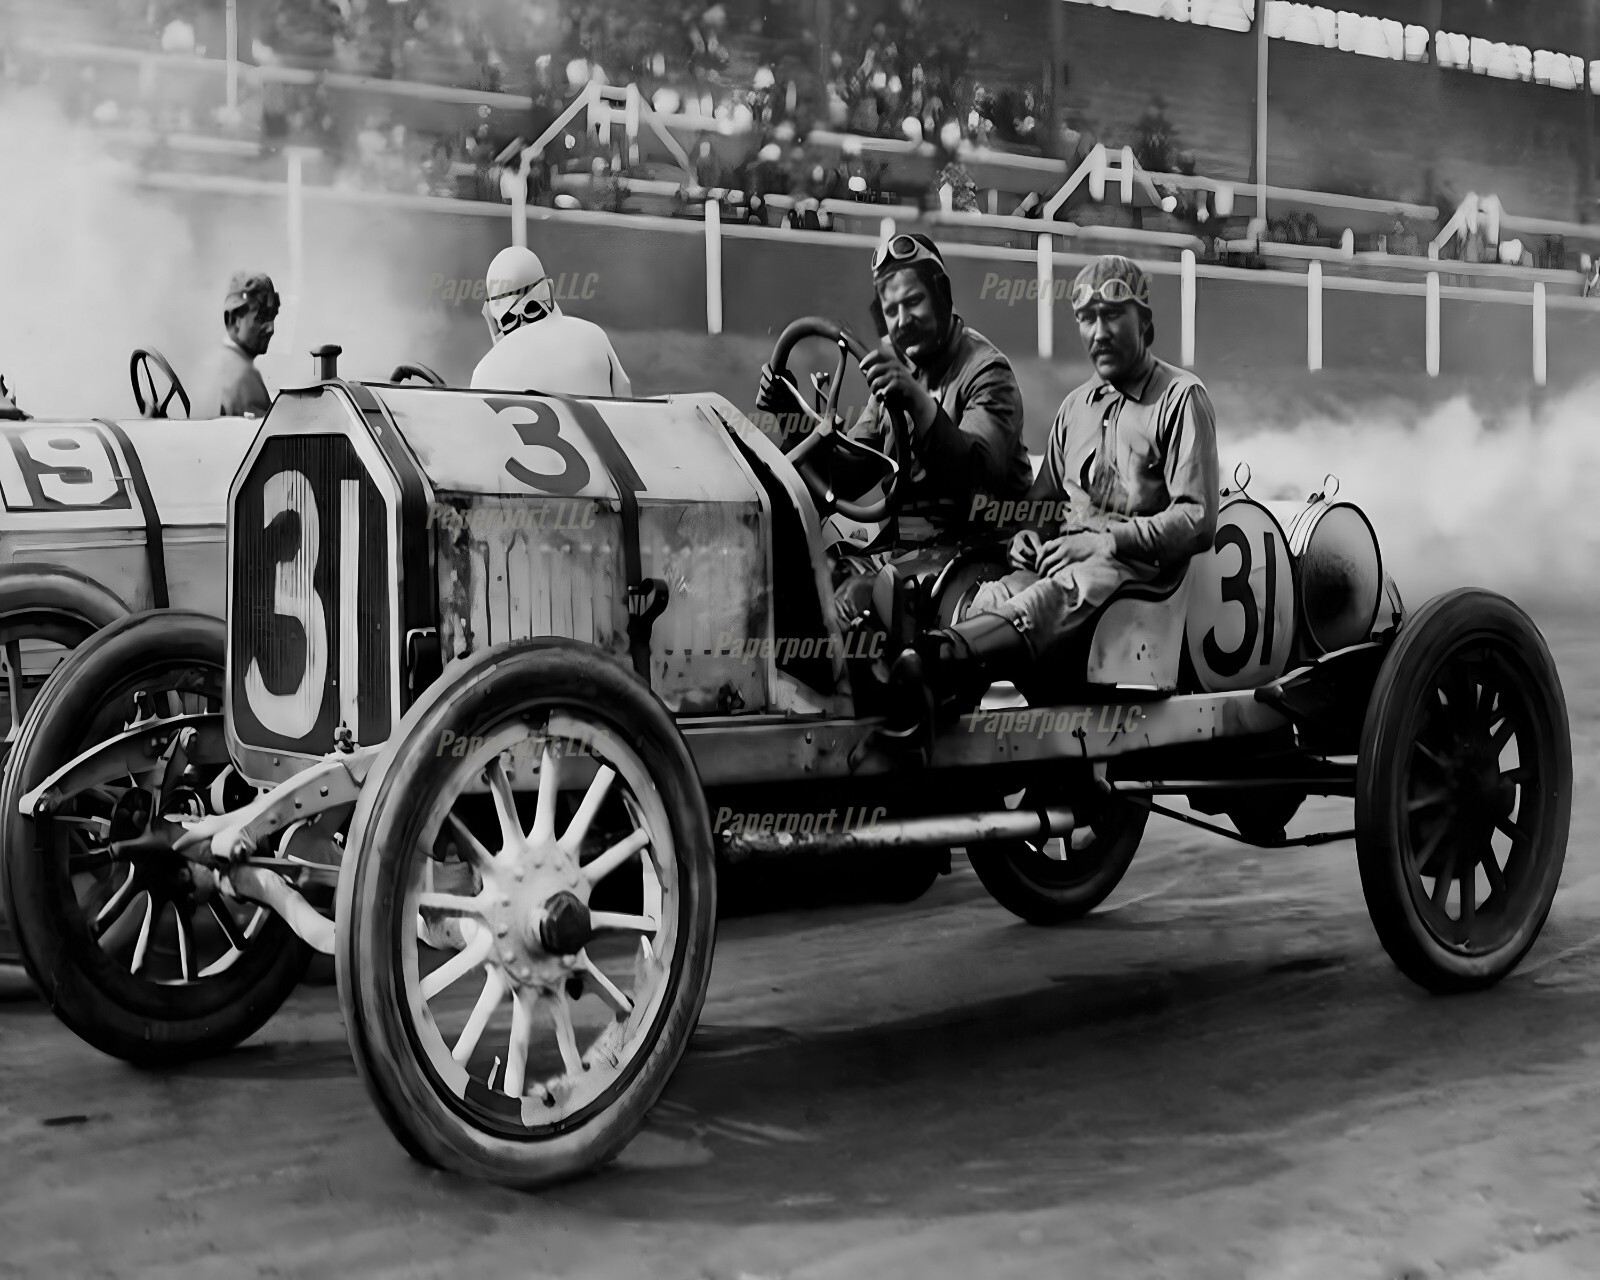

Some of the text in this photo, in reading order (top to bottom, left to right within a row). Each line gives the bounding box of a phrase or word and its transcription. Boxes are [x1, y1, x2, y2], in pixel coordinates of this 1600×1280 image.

[484, 399, 647, 496] 31
[244, 469, 359, 741] 31
[1203, 523, 1277, 678] 31
